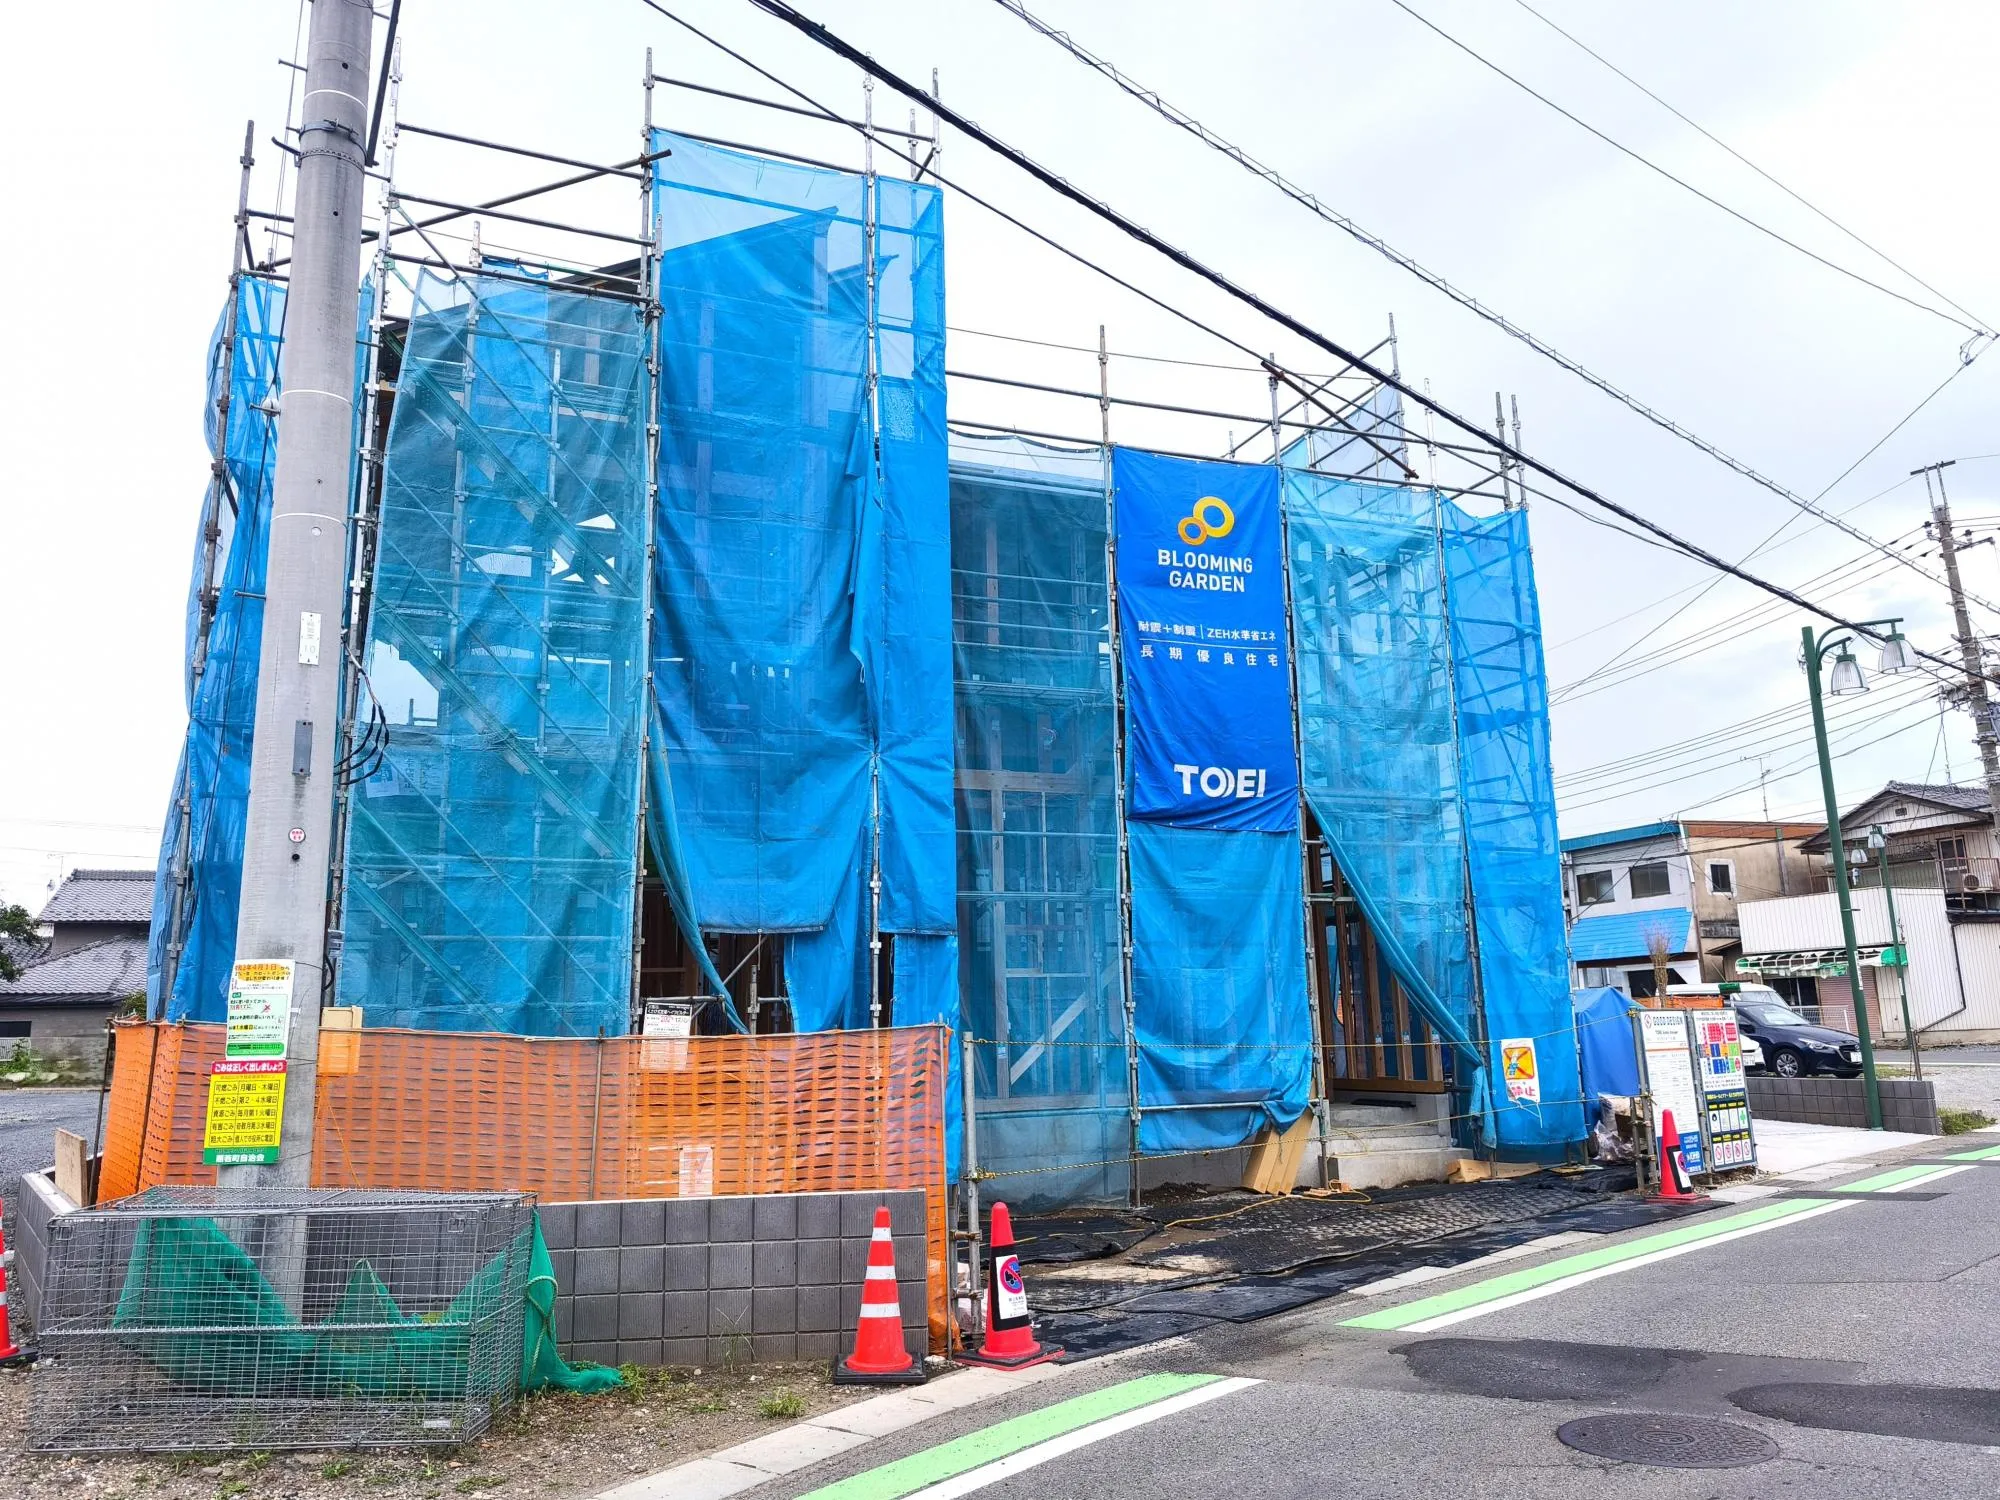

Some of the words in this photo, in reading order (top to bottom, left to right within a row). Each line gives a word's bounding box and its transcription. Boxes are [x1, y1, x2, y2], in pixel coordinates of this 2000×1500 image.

[1158, 549, 1253, 574] BLOOMING
[1169, 570, 1246, 593] GARDEN
[1206, 627, 1277, 642] ZEH水準省エネ
[1140, 644, 1279, 667] 長期優良住宅
[1173, 763, 1266, 798] TOEI
[214, 1062, 284, 1073] ごみは正しく出しましょう
[215, 1083, 238, 1092] 可燃ごみ
[240, 1083, 279, 1092] 月曜日・木曜日
[215, 1096, 237, 1105] 不燃ごみ
[210, 1135, 233, 1143] 粗大ごみ
